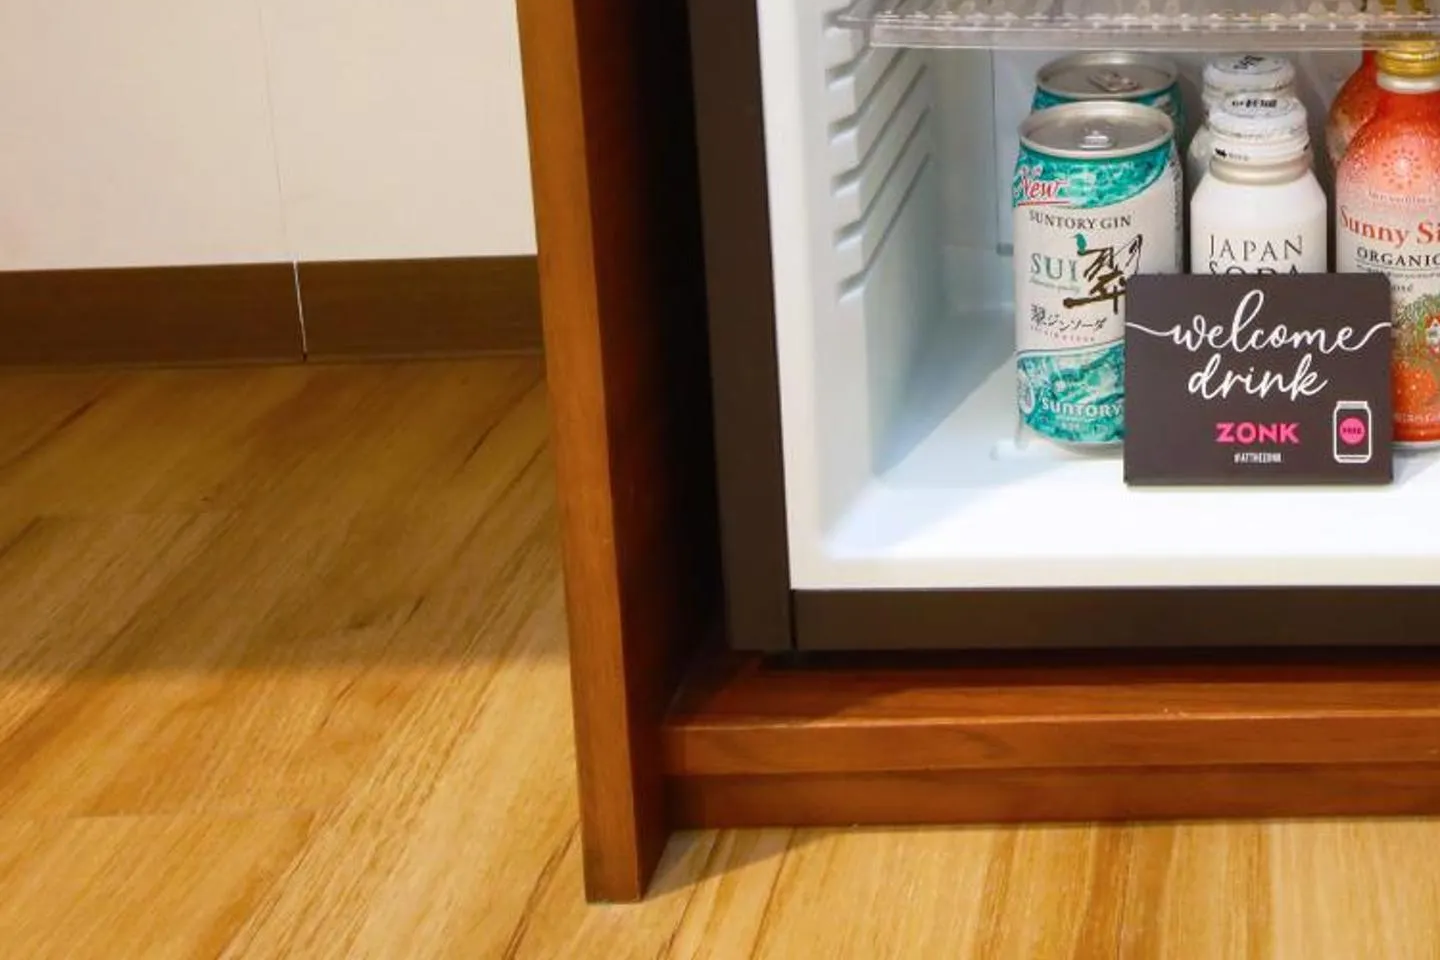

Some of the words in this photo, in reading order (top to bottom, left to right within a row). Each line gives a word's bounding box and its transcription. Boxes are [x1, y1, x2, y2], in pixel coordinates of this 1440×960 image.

[1029, 210, 1096, 230] SUNTORY
[1100, 215, 1132, 230] GIN
[1341, 205, 1409, 248] Sunny
[1207, 234, 1303, 262] JAPAN
[1030, 252, 1079, 282] SUI
[1125, 289, 1391, 353] welcome
[1188, 353, 1329, 400] drink
[1041, 396, 1124, 418] SUNTORY
[1215, 421, 1300, 444] ZONK
